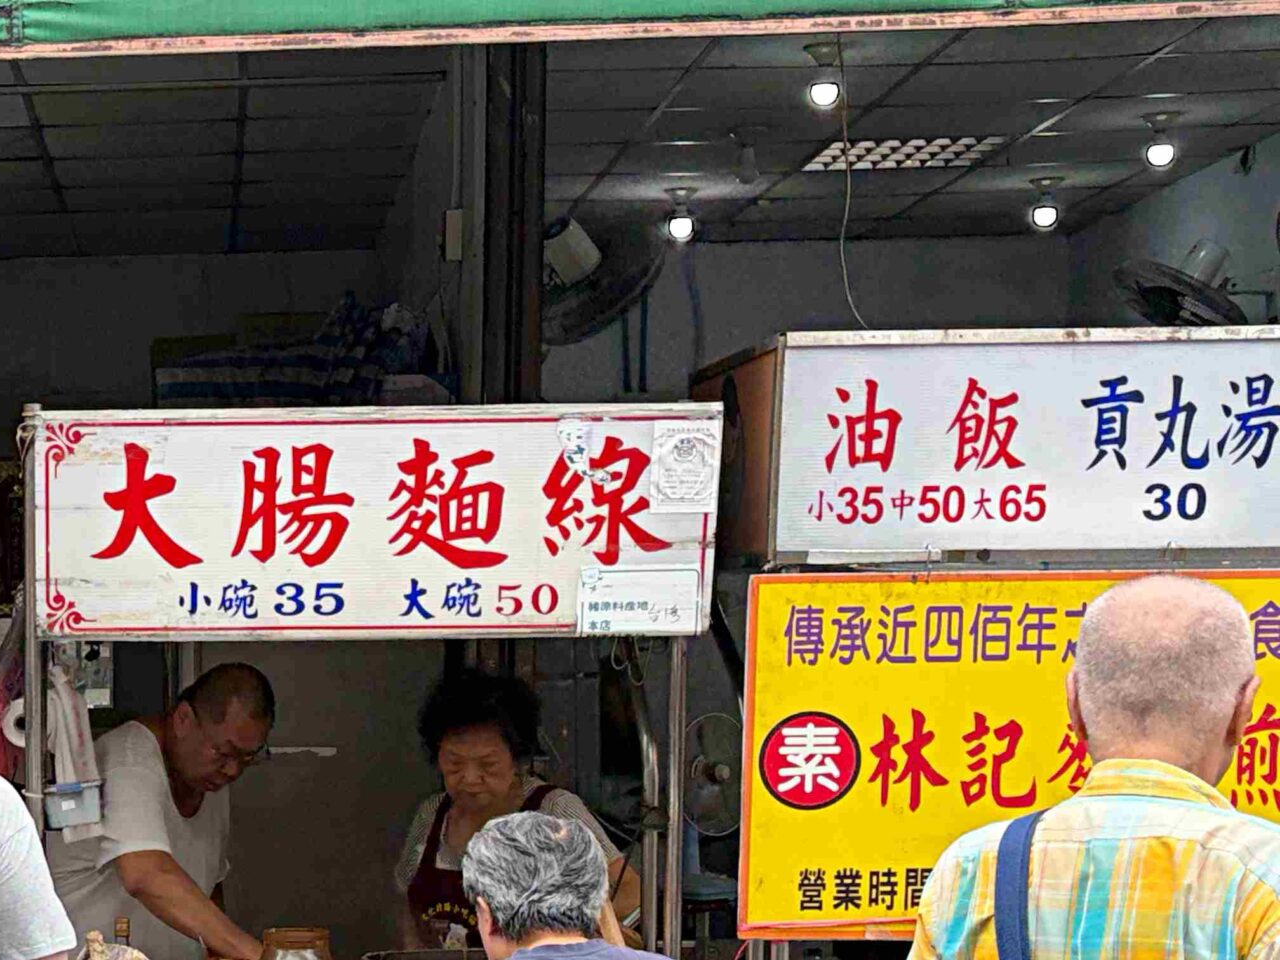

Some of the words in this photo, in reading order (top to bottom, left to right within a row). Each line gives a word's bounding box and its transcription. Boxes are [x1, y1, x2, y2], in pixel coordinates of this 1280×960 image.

[824, 376, 1026, 474] 油飯
[1081, 373, 1280, 471] 貢丸湯
[90, 435, 674, 567] 大腸麵線
[1142, 483, 1207, 521] 30
[778, 722, 842, 794] 素
